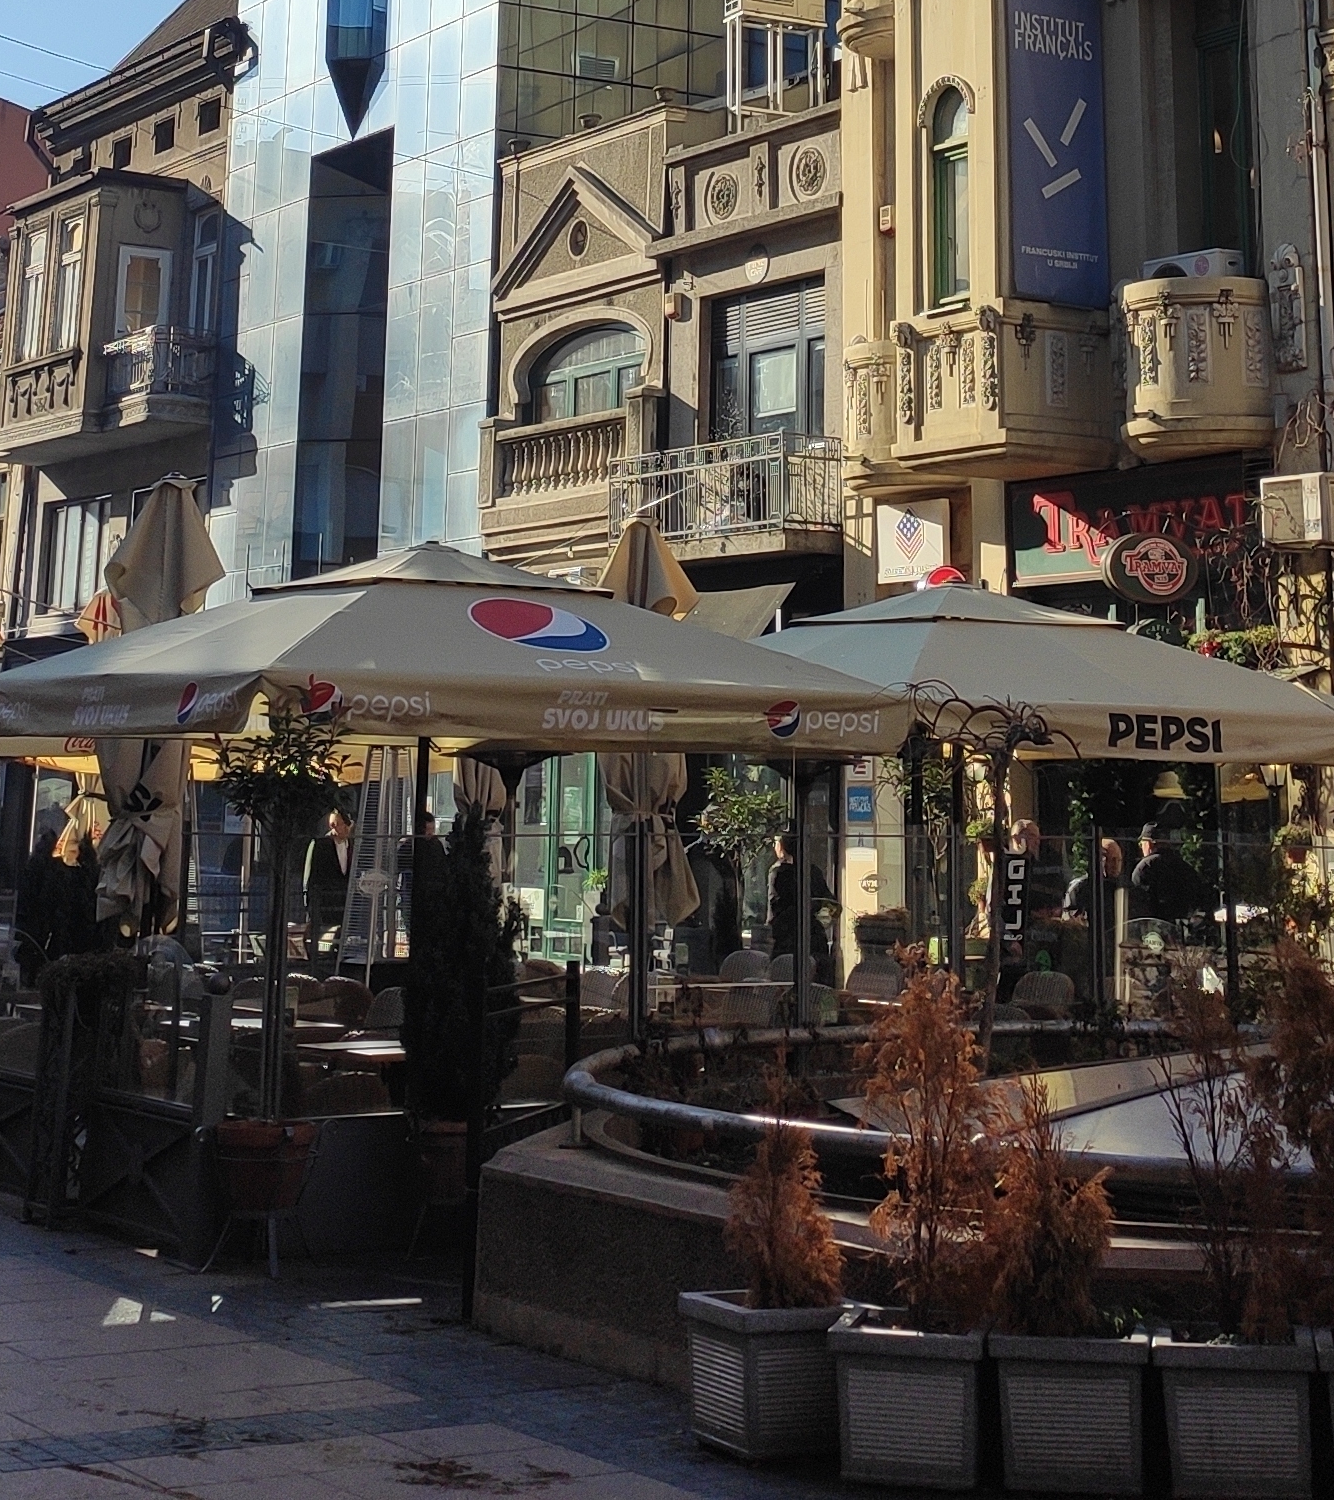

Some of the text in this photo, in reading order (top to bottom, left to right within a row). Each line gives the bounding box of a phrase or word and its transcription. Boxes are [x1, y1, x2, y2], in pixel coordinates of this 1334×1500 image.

[1014, 10, 1085, 43] INSTITUT
[1014, 28, 1093, 61] FRANÇAIS
[1021, 245, 1099, 263] FRANCUSKI INSTITUT
[1047, 258, 1054, 267] U
[1124, 553, 1186, 574] TRAMVAJ
[347, 690, 431, 722] pepsi
[557, 690, 610, 706] PRATI
[71, 704, 100, 726] SVOJ
[542, 708, 665, 732] SVOJ UKUS
[805, 709, 880, 738] pepsi
[1107, 712, 1224, 753] PEPSI
